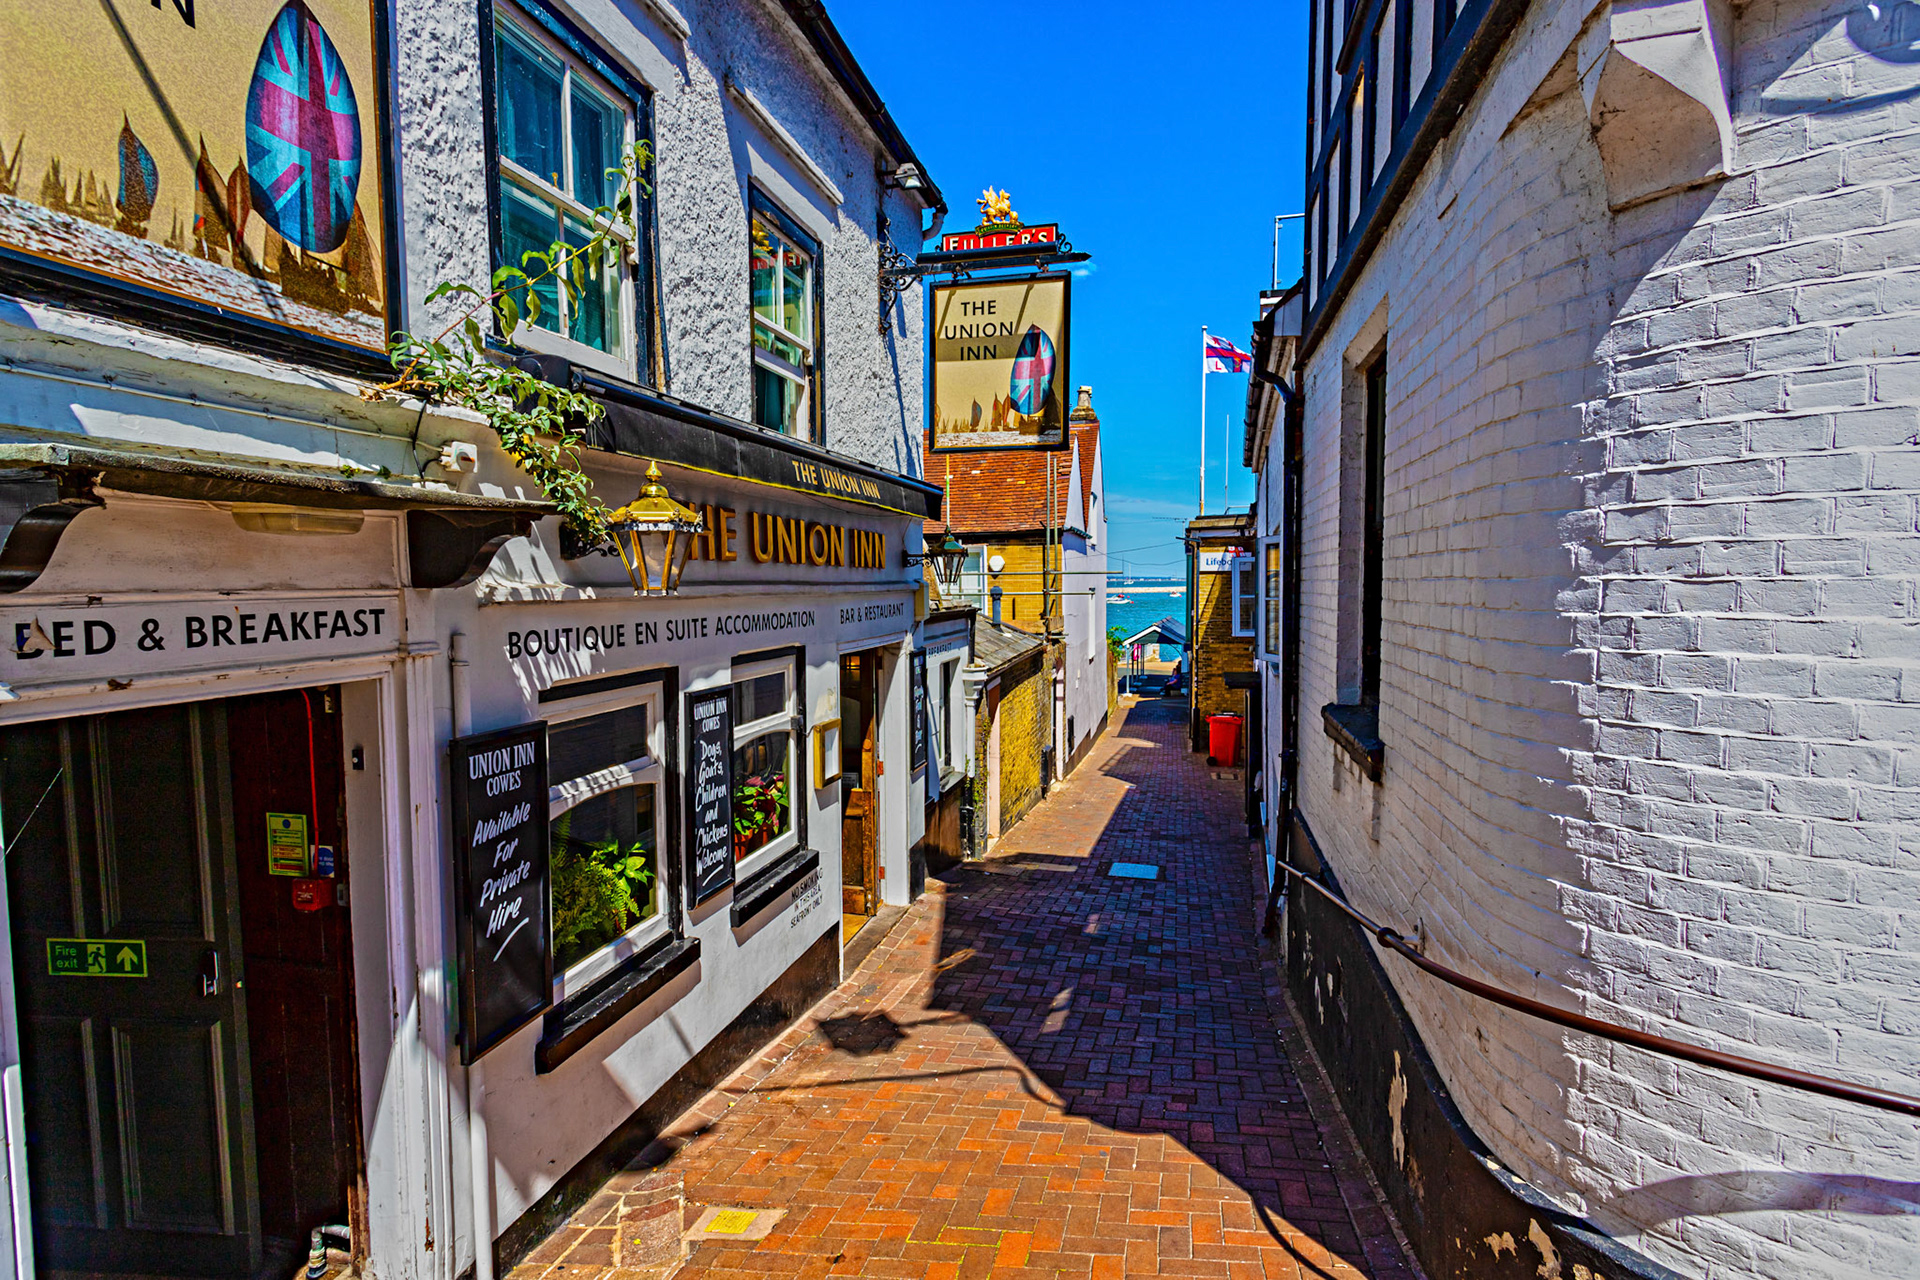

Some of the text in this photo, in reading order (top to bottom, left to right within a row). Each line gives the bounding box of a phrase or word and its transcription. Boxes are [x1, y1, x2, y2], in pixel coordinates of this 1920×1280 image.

[961, 300, 997, 317] THE
[945, 321, 1013, 340] UNION
[960, 345, 997, 361] INN
[792, 460, 881, 500] THE UNION INN
[684, 501, 886, 569] HE UNION INN
[840, 602, 905, 625] BAR & RESTAURANT
[137, 618, 166, 652] &
[185, 608, 386, 649] BREAKFAST
[508, 611, 815, 659] BOUTIQUE EN SUITE ACCOMMODATION
[694, 696, 727, 720] UNION INN
[702, 716, 720, 733] COWES
[469, 741, 535, 780] UNION INN
[700, 740, 722, 762] Dogs,
[486, 770, 521, 797] COWES
[698, 760, 724, 787] Goats,
[695, 783, 727, 812] Children
[472, 801, 531, 848] Available
[704, 801, 719, 824] and
[493, 838, 519, 868] For
[695, 823, 728, 855] Chickens
[696, 846, 728, 877] Welcome
[479, 860, 531, 908] Private
[791, 867, 824, 902] NO SMOKING
[486, 896, 522, 939] Hire
[55, 945, 77, 956] Fire
[56, 958, 78, 969] exit
